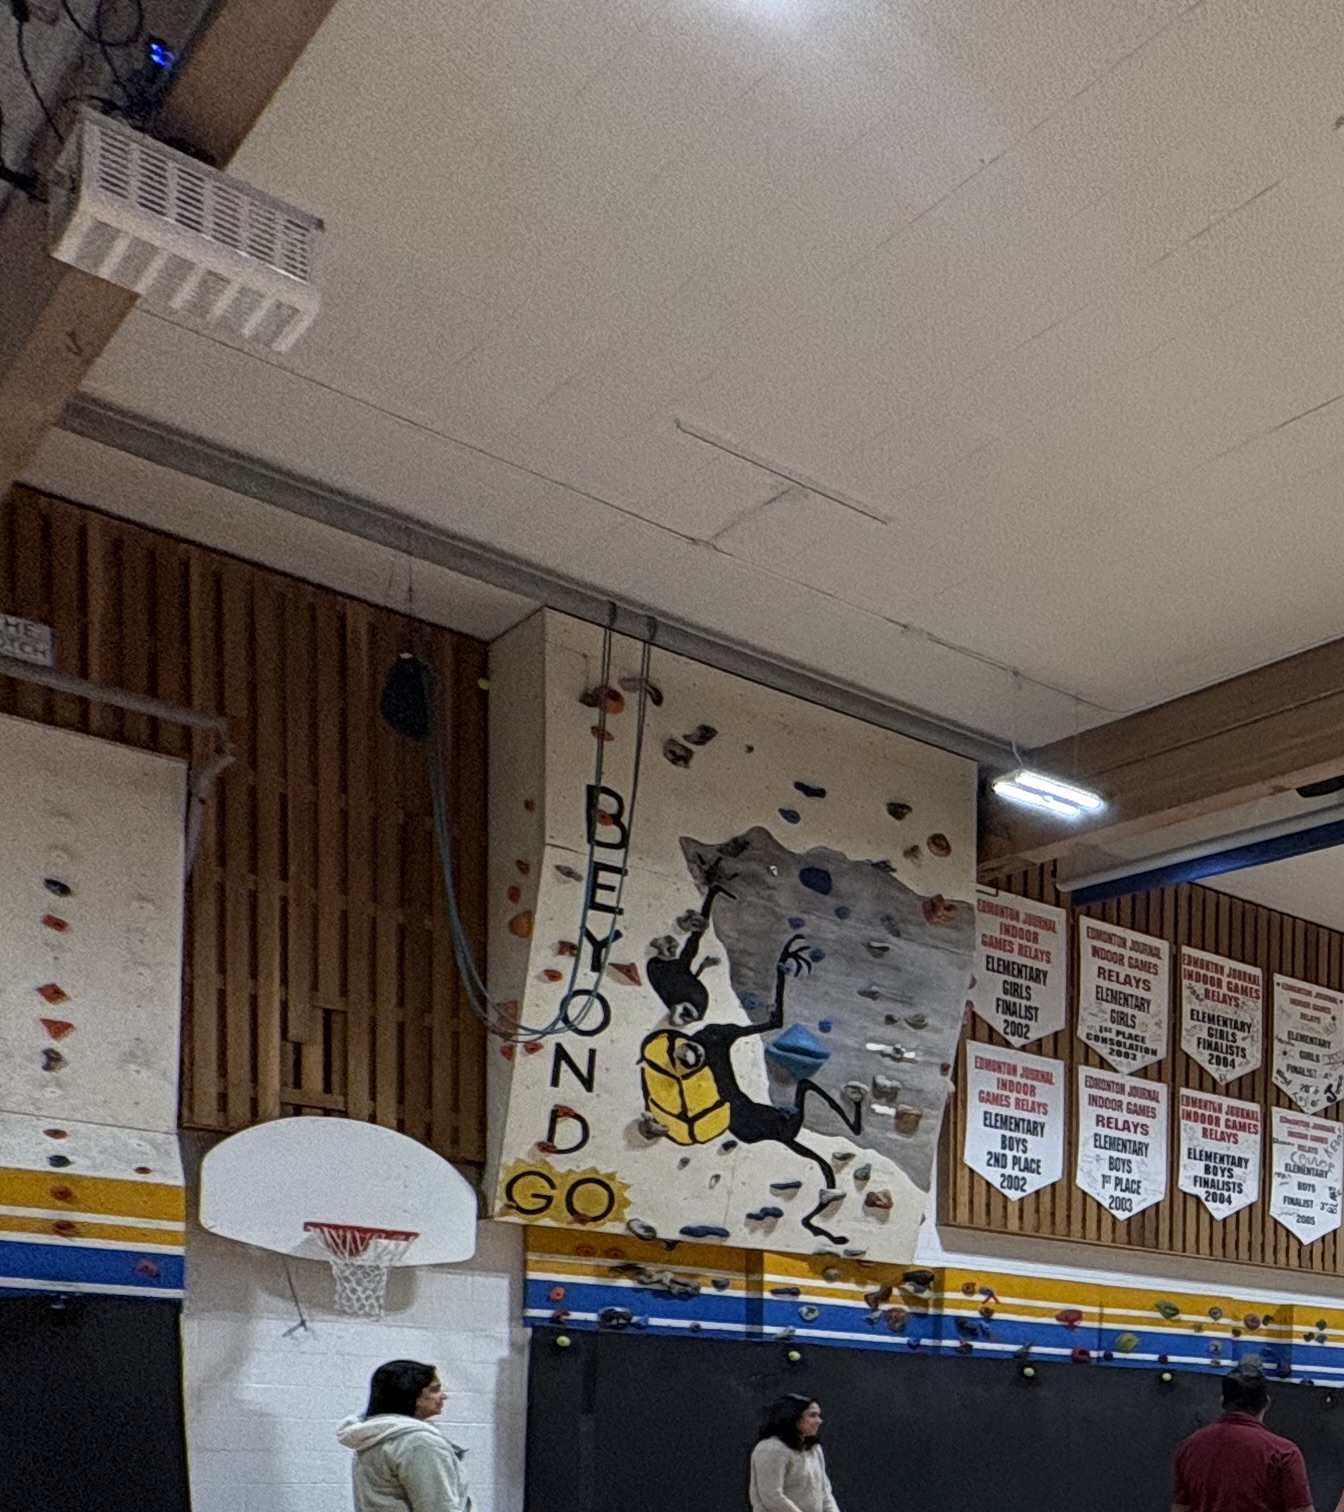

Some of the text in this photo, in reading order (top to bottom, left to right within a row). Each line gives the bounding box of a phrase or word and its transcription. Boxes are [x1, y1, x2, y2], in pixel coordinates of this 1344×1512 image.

[977, 898, 1020, 922] EDMONTON
[1000, 922, 1039, 945] INDOOR
[981, 933, 1051, 964] GAMES RELAYS
[547, 784, 629, 1155] BEYOND
[986, 955, 1048, 986] ELEMENTARY
[1091, 945, 1159, 976] INDOOR GAMES
[1183, 953, 1260, 987] EDMONTON JOURNAL
[1097, 966, 1152, 992] RELAYS
[1183, 968, 1260, 1000] INDOOR GAMES
[1003, 980, 1032, 1001] GIRLS
[1096, 985, 1152, 1014] ELEMENTARY
[1204, 988, 1240, 1008] RELAYS
[996, 997, 1039, 1022] FINALIST
[1110, 1009, 1136, 1029] GIRLS
[1300, 1012, 1321, 1024] RELAYS
[1003, 1019, 1030, 1040] 2002
[1190, 1008, 1252, 1034] ELEMENTARY
[1086, 1032, 1158, 1056] CONSOLATION
[1116, 1030, 1146, 1044] PLACE
[1207, 1027, 1237, 1044] GIRLS
[1288, 1030, 1331, 1049] ELEMENTARY
[1109, 1048, 1137, 1061] 2003
[1197, 1037, 1247, 1059] FINALISTS
[1299, 1050, 1320, 1063] GIRLS
[974, 1055, 1055, 1085] EDMONTON JOURNAL
[1208, 1053, 1236, 1069] 2004
[1286, 1063, 1317, 1079] FINALIST
[997, 1077, 1036, 1097] INDOOR
[1085, 1075, 1160, 1103] EDMONTON JOURNAL
[978, 1090, 1048, 1116] GAMES RELAYS
[1088, 1094, 1157, 1119] INDOOR GAMES
[1181, 1094, 1260, 1122] EDMONTON JOURNAL
[983, 1111, 1045, 1138] ELEMENTARY
[1096, 1114, 1150, 1136] RELAYS
[1182, 1109, 1259, 1135] INDOOR GAMES
[1001, 1134, 1028, 1154] BOYS
[1094, 1133, 1150, 1158] ELEMENTARY
[1202, 1127, 1239, 1145] RELAYS
[1187, 1147, 1249, 1169] ELEMENTARY
[1298, 1144, 1318, 1155] RELAYS
[987, 1151, 1041, 1175] 2ND PLACE
[1109, 1156, 1132, 1174] BOYS
[1204, 1164, 1234, 1179] BOYS
[1285, 1163, 1329, 1179] ELEMENTARY
[1000, 1173, 1027, 1192] 2002
[1114, 1176, 1142, 1195] PLACE
[1193, 1175, 1243, 1194] FINALISTS
[1297, 1181, 1316, 1193] BOYS
[505, 1170, 615, 1223] GO
[1109, 1195, 1133, 1213] 2003
[1205, 1191, 1232, 1205] 2004
[1283, 1196, 1314, 1208] FINALIST
[1296, 1214, 1315, 1225] 2005
